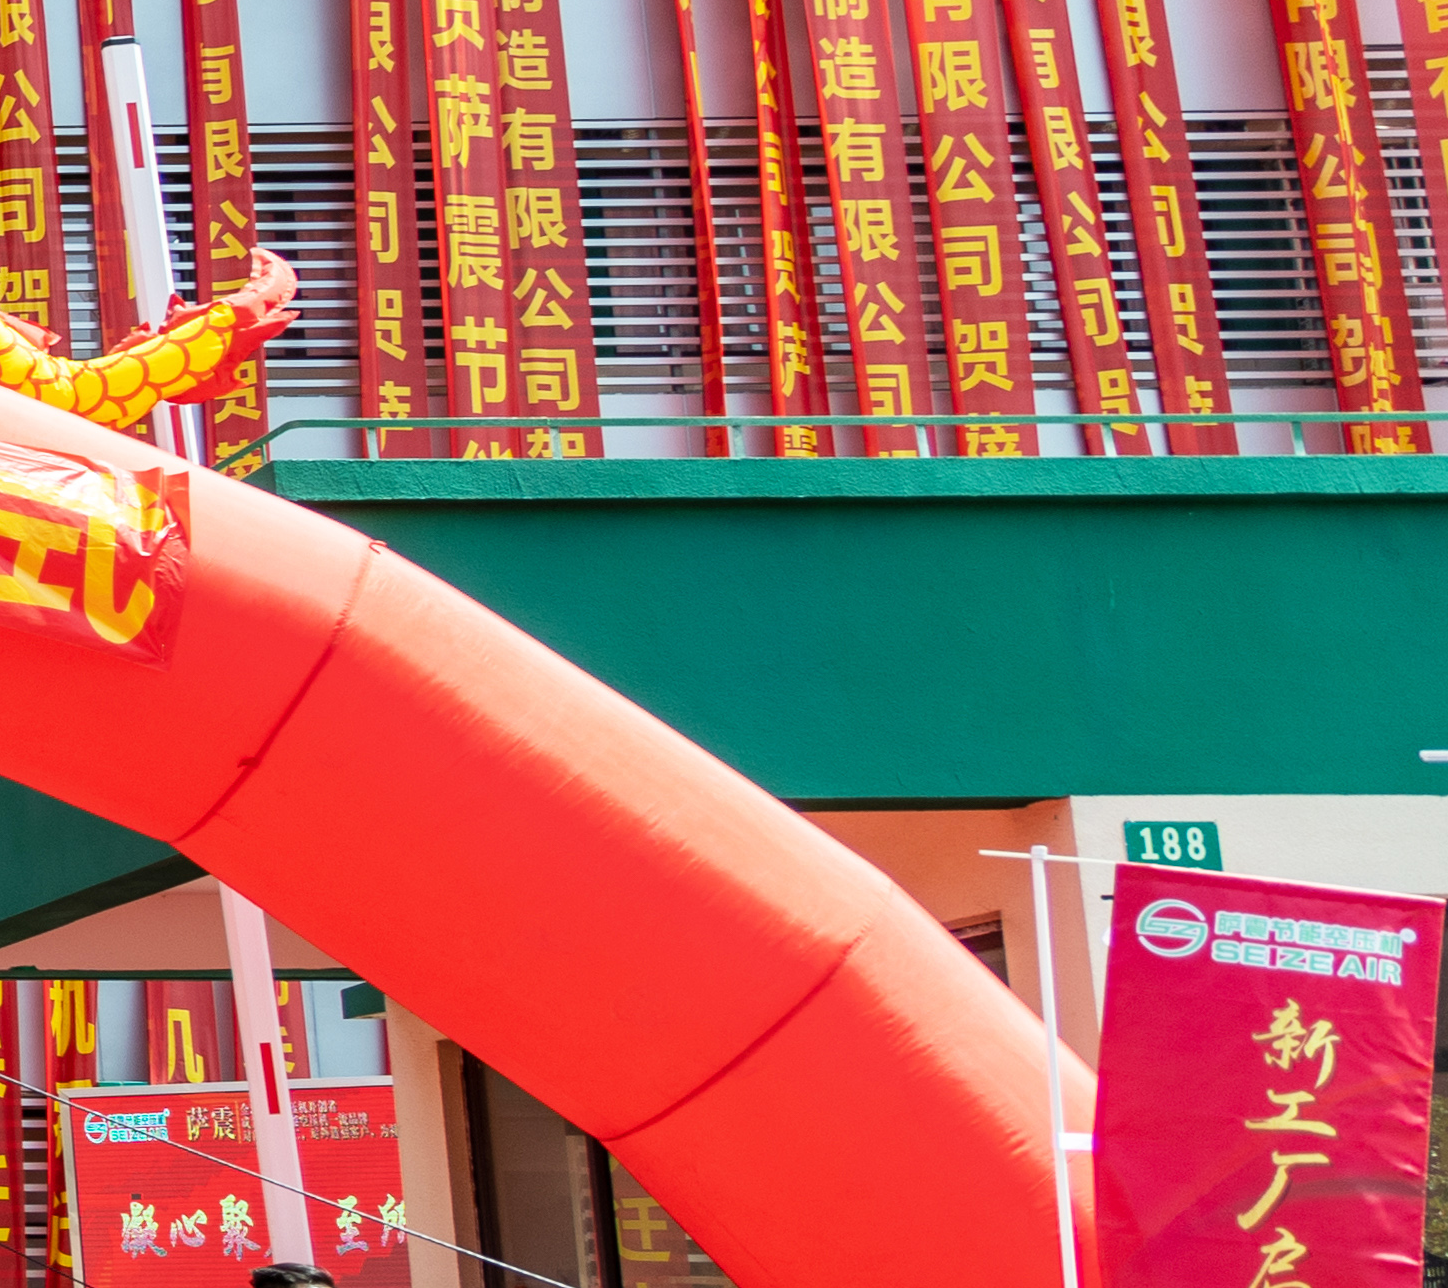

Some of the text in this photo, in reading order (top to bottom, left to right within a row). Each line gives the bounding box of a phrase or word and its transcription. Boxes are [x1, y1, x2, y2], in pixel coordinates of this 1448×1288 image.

[1138, 826, 1207, 860] 188
[186, 1106, 235, 1141] 萨震
[120, 1193, 273, 1262] 凝心聚
